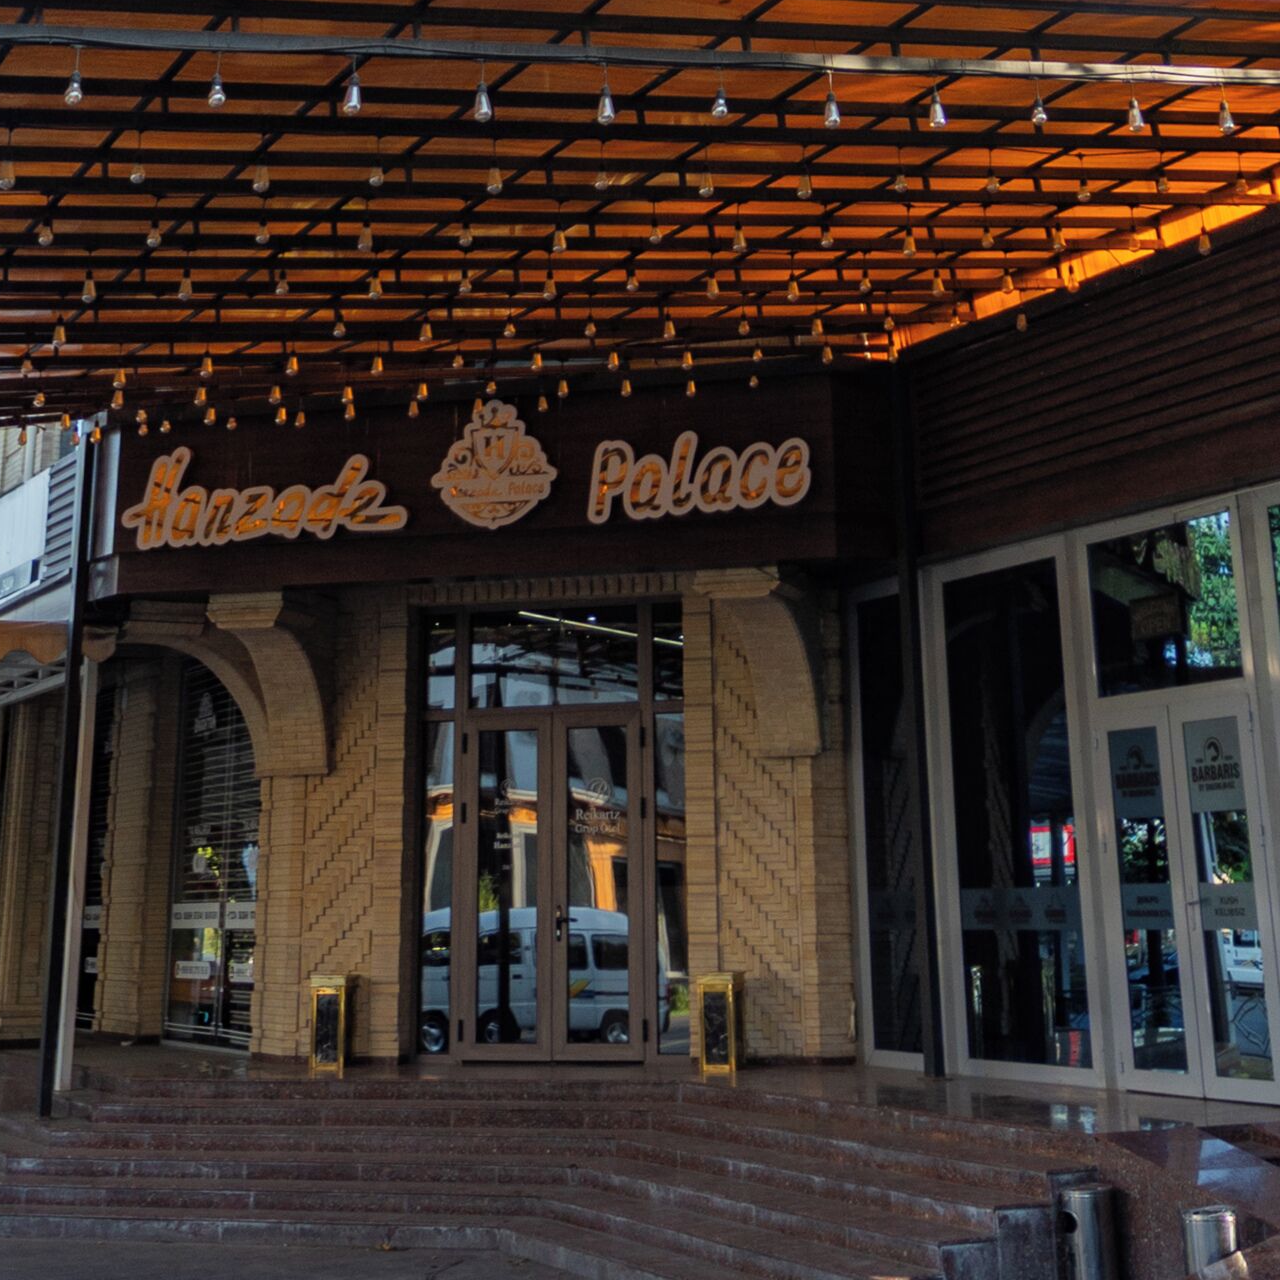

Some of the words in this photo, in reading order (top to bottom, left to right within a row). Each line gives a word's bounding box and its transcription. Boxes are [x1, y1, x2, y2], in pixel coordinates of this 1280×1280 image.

[123, 447, 407, 550] Hanzade
[588, 431, 810, 523] Palace
[1191, 762, 1241, 783] BARBARIS
[575, 808, 620, 821] Reikartz
